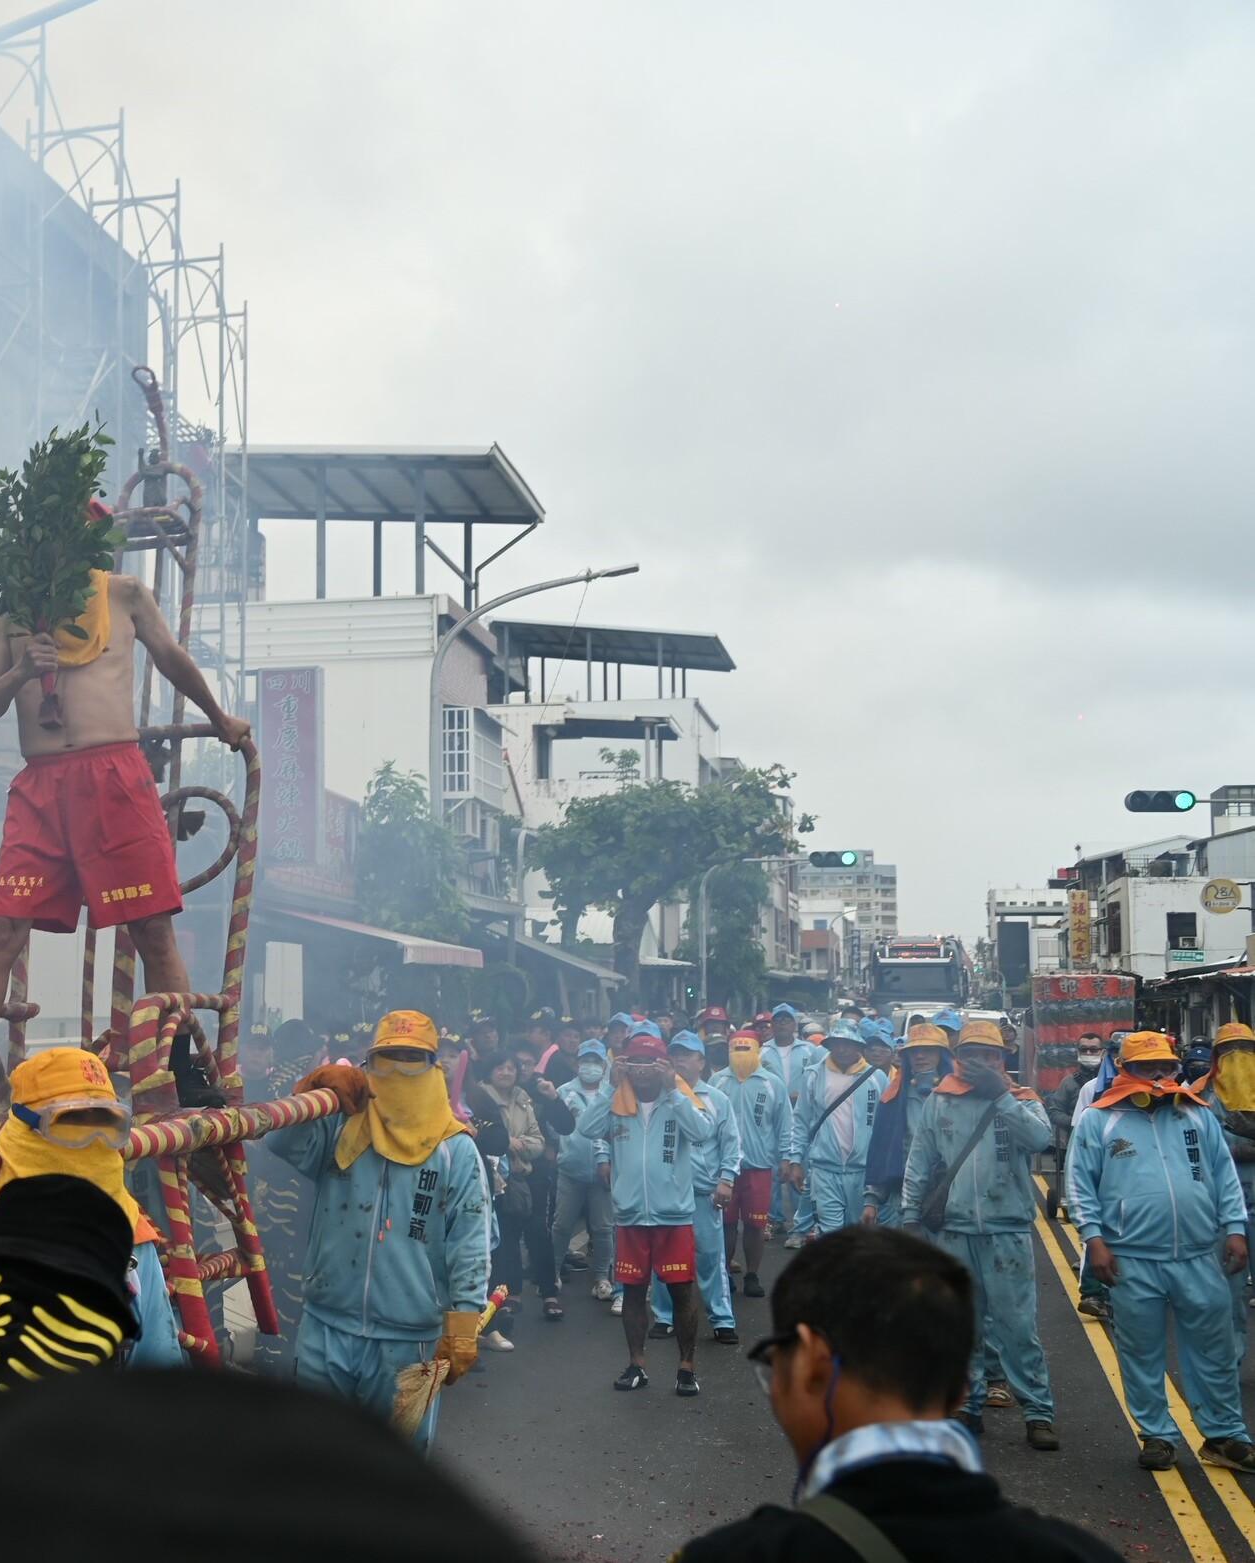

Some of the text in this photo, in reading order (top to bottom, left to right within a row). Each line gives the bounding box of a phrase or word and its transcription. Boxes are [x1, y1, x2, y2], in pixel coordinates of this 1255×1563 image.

[265, 670, 311, 693] 四川
[407, 1168, 439, 1244] 邯鄲爺
